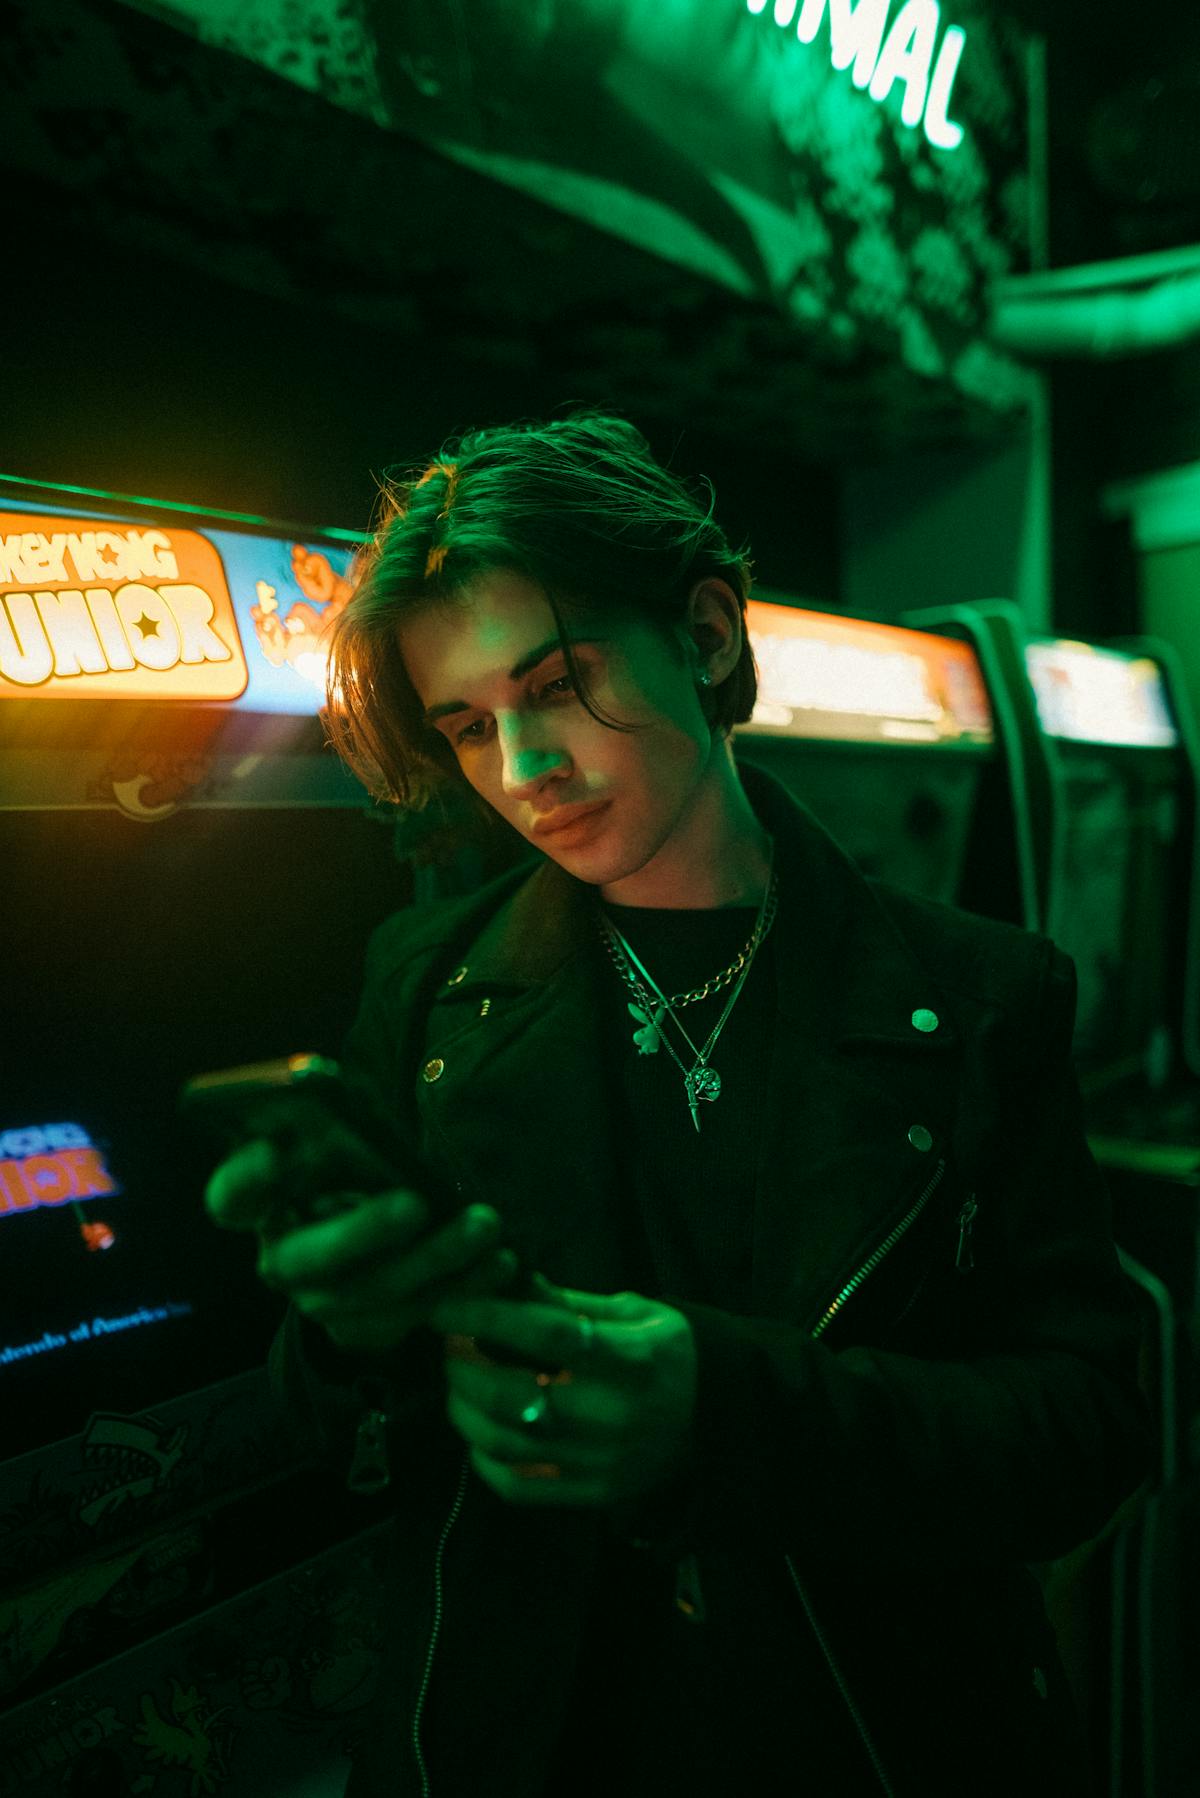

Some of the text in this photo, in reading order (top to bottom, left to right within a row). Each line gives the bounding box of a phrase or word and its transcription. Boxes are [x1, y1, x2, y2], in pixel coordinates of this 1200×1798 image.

[0, 530, 179, 584] KEY KONG
[69, 1322, 91, 1342] of
